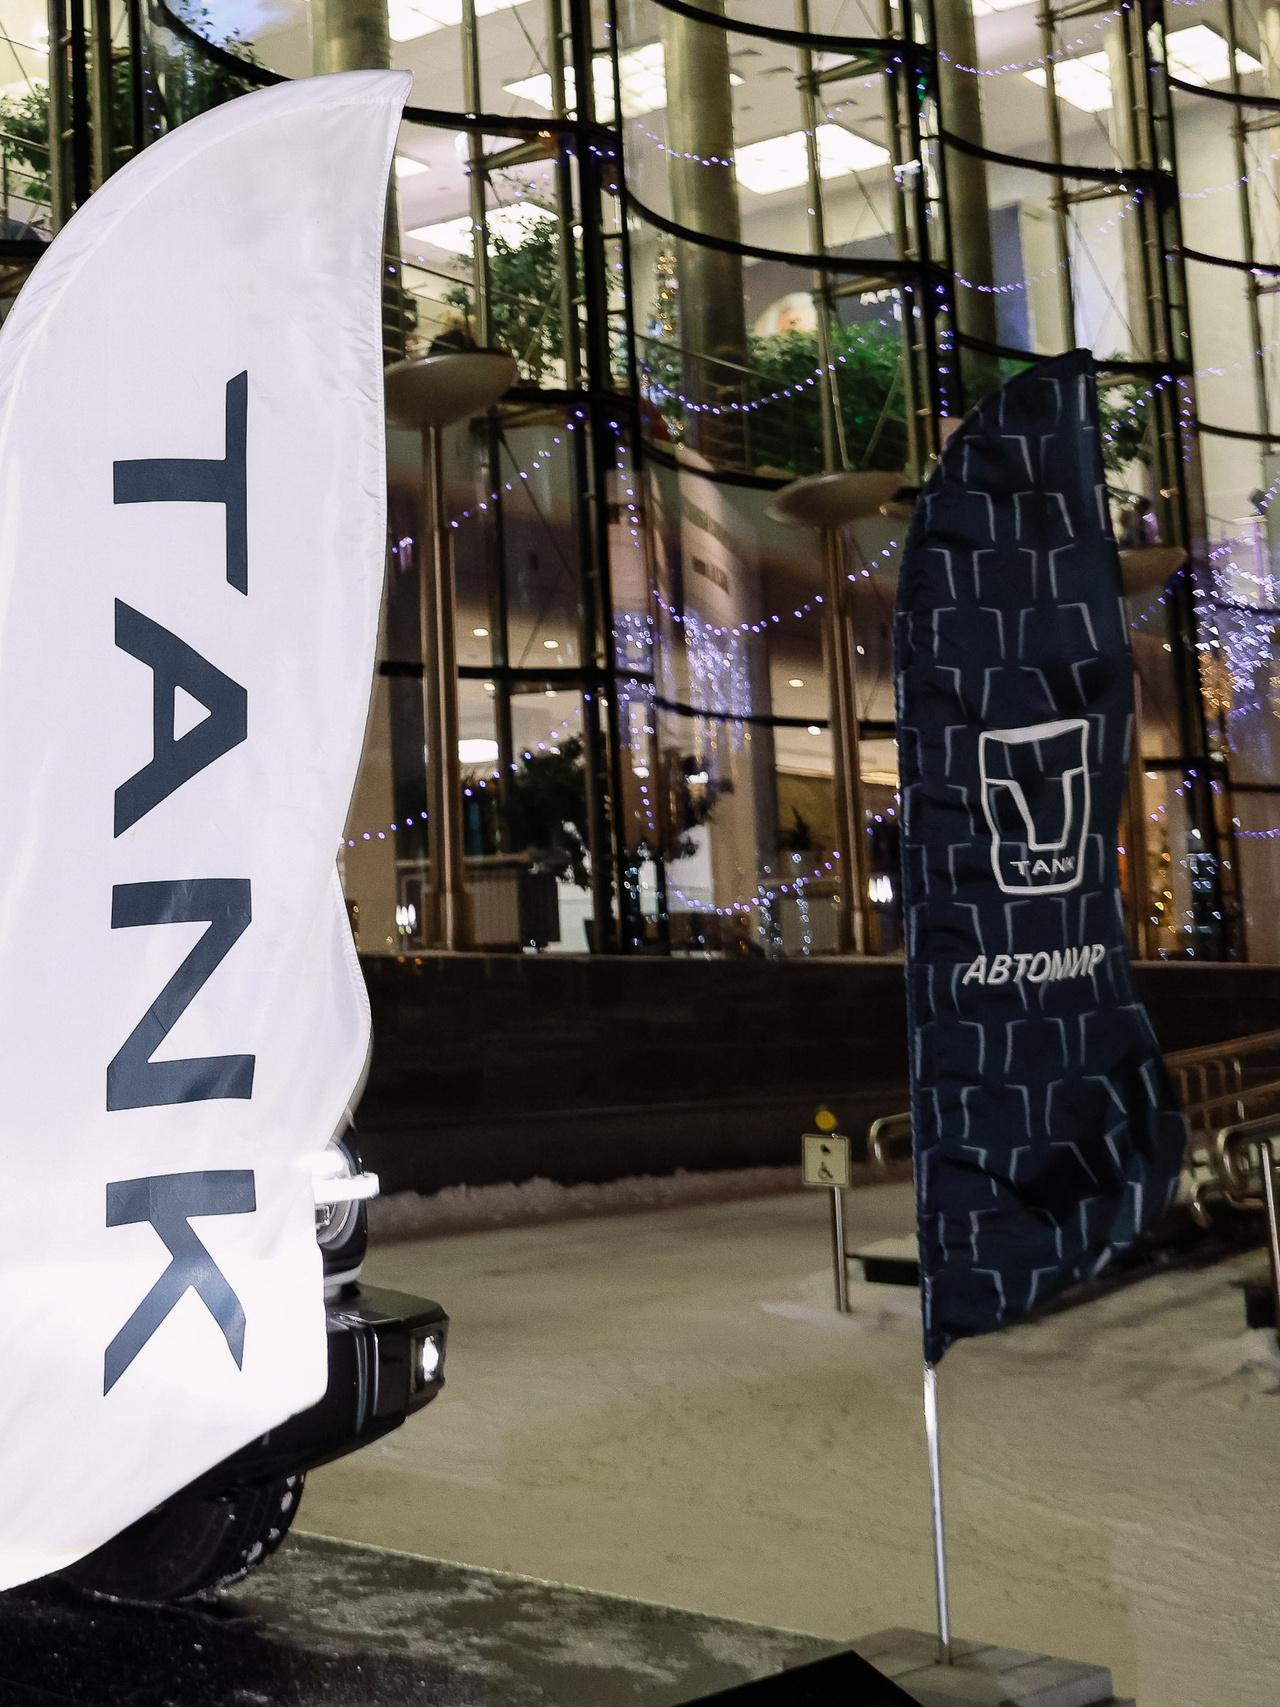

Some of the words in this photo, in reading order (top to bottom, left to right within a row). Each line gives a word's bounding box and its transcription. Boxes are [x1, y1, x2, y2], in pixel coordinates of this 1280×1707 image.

[104, 369, 256, 1396] TANK
[1009, 856, 1075, 876] TANK
[962, 944, 1105, 986] АВТОМИР
